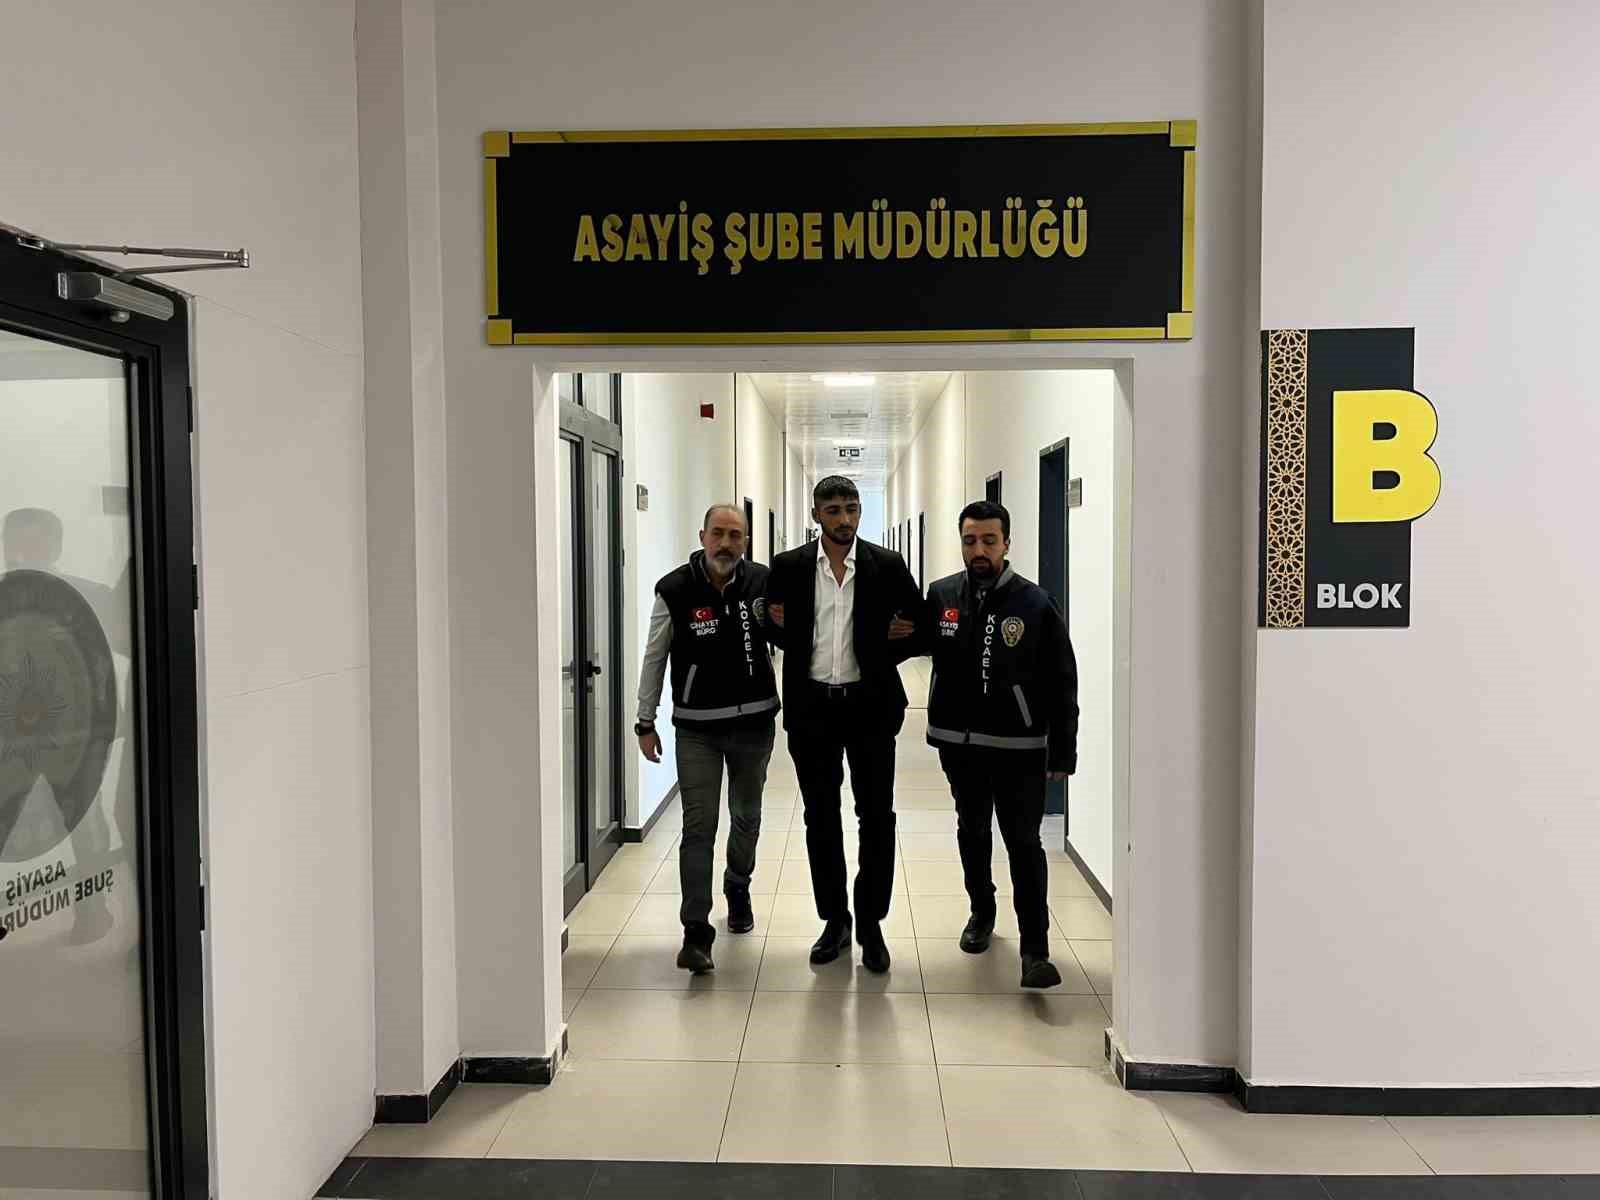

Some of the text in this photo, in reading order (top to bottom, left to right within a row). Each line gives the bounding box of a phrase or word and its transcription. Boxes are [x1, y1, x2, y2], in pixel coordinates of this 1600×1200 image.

[574, 196, 1088, 276] ASAYİŞ ŞUBE MÜDÜRLÜĞÜ
[1332, 389, 1441, 522] B
[1316, 582, 1403, 610] BLOK
